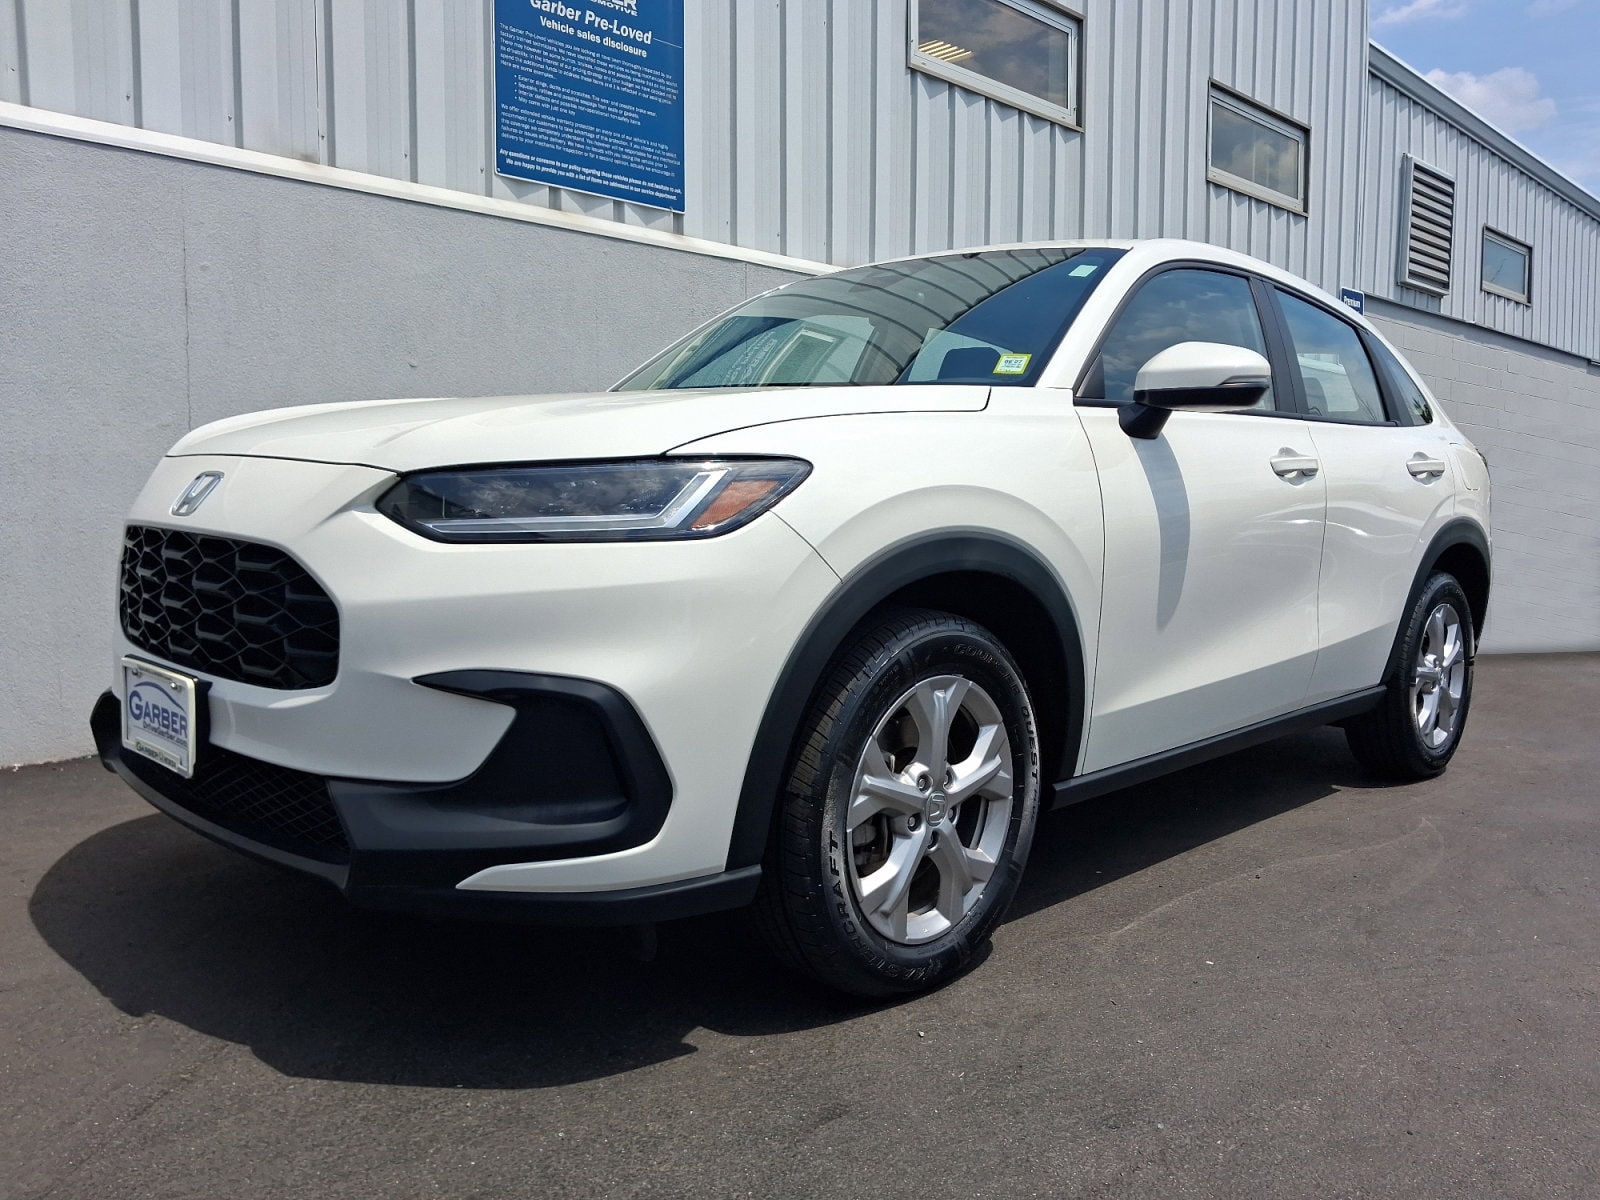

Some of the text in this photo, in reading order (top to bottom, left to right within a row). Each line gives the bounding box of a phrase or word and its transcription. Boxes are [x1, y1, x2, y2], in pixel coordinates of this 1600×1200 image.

[530, 0, 652, 44] Garber Pre-Loved
[540, 16, 648, 58] Vehicle sales disclosure
[129, 690, 188, 738] GARBER
